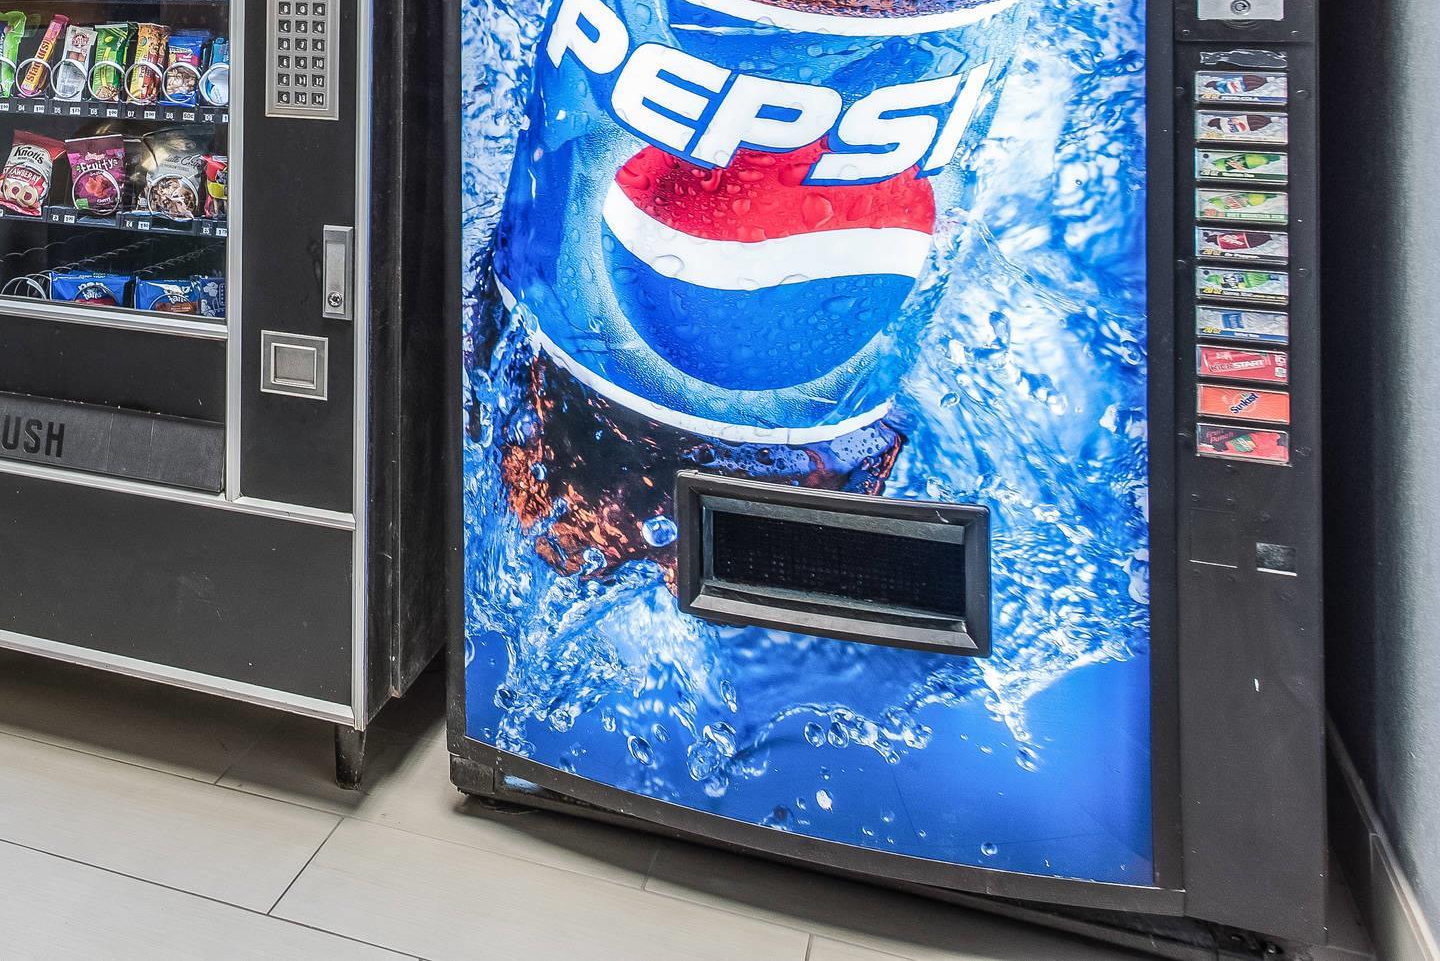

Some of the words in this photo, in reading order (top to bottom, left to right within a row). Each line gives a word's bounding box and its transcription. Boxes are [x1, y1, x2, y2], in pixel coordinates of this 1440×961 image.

[13, 146, 45, 164] Knott's
[80, 159, 113, 172] Fruity
[1230, 392, 1259, 414] Sunkist
